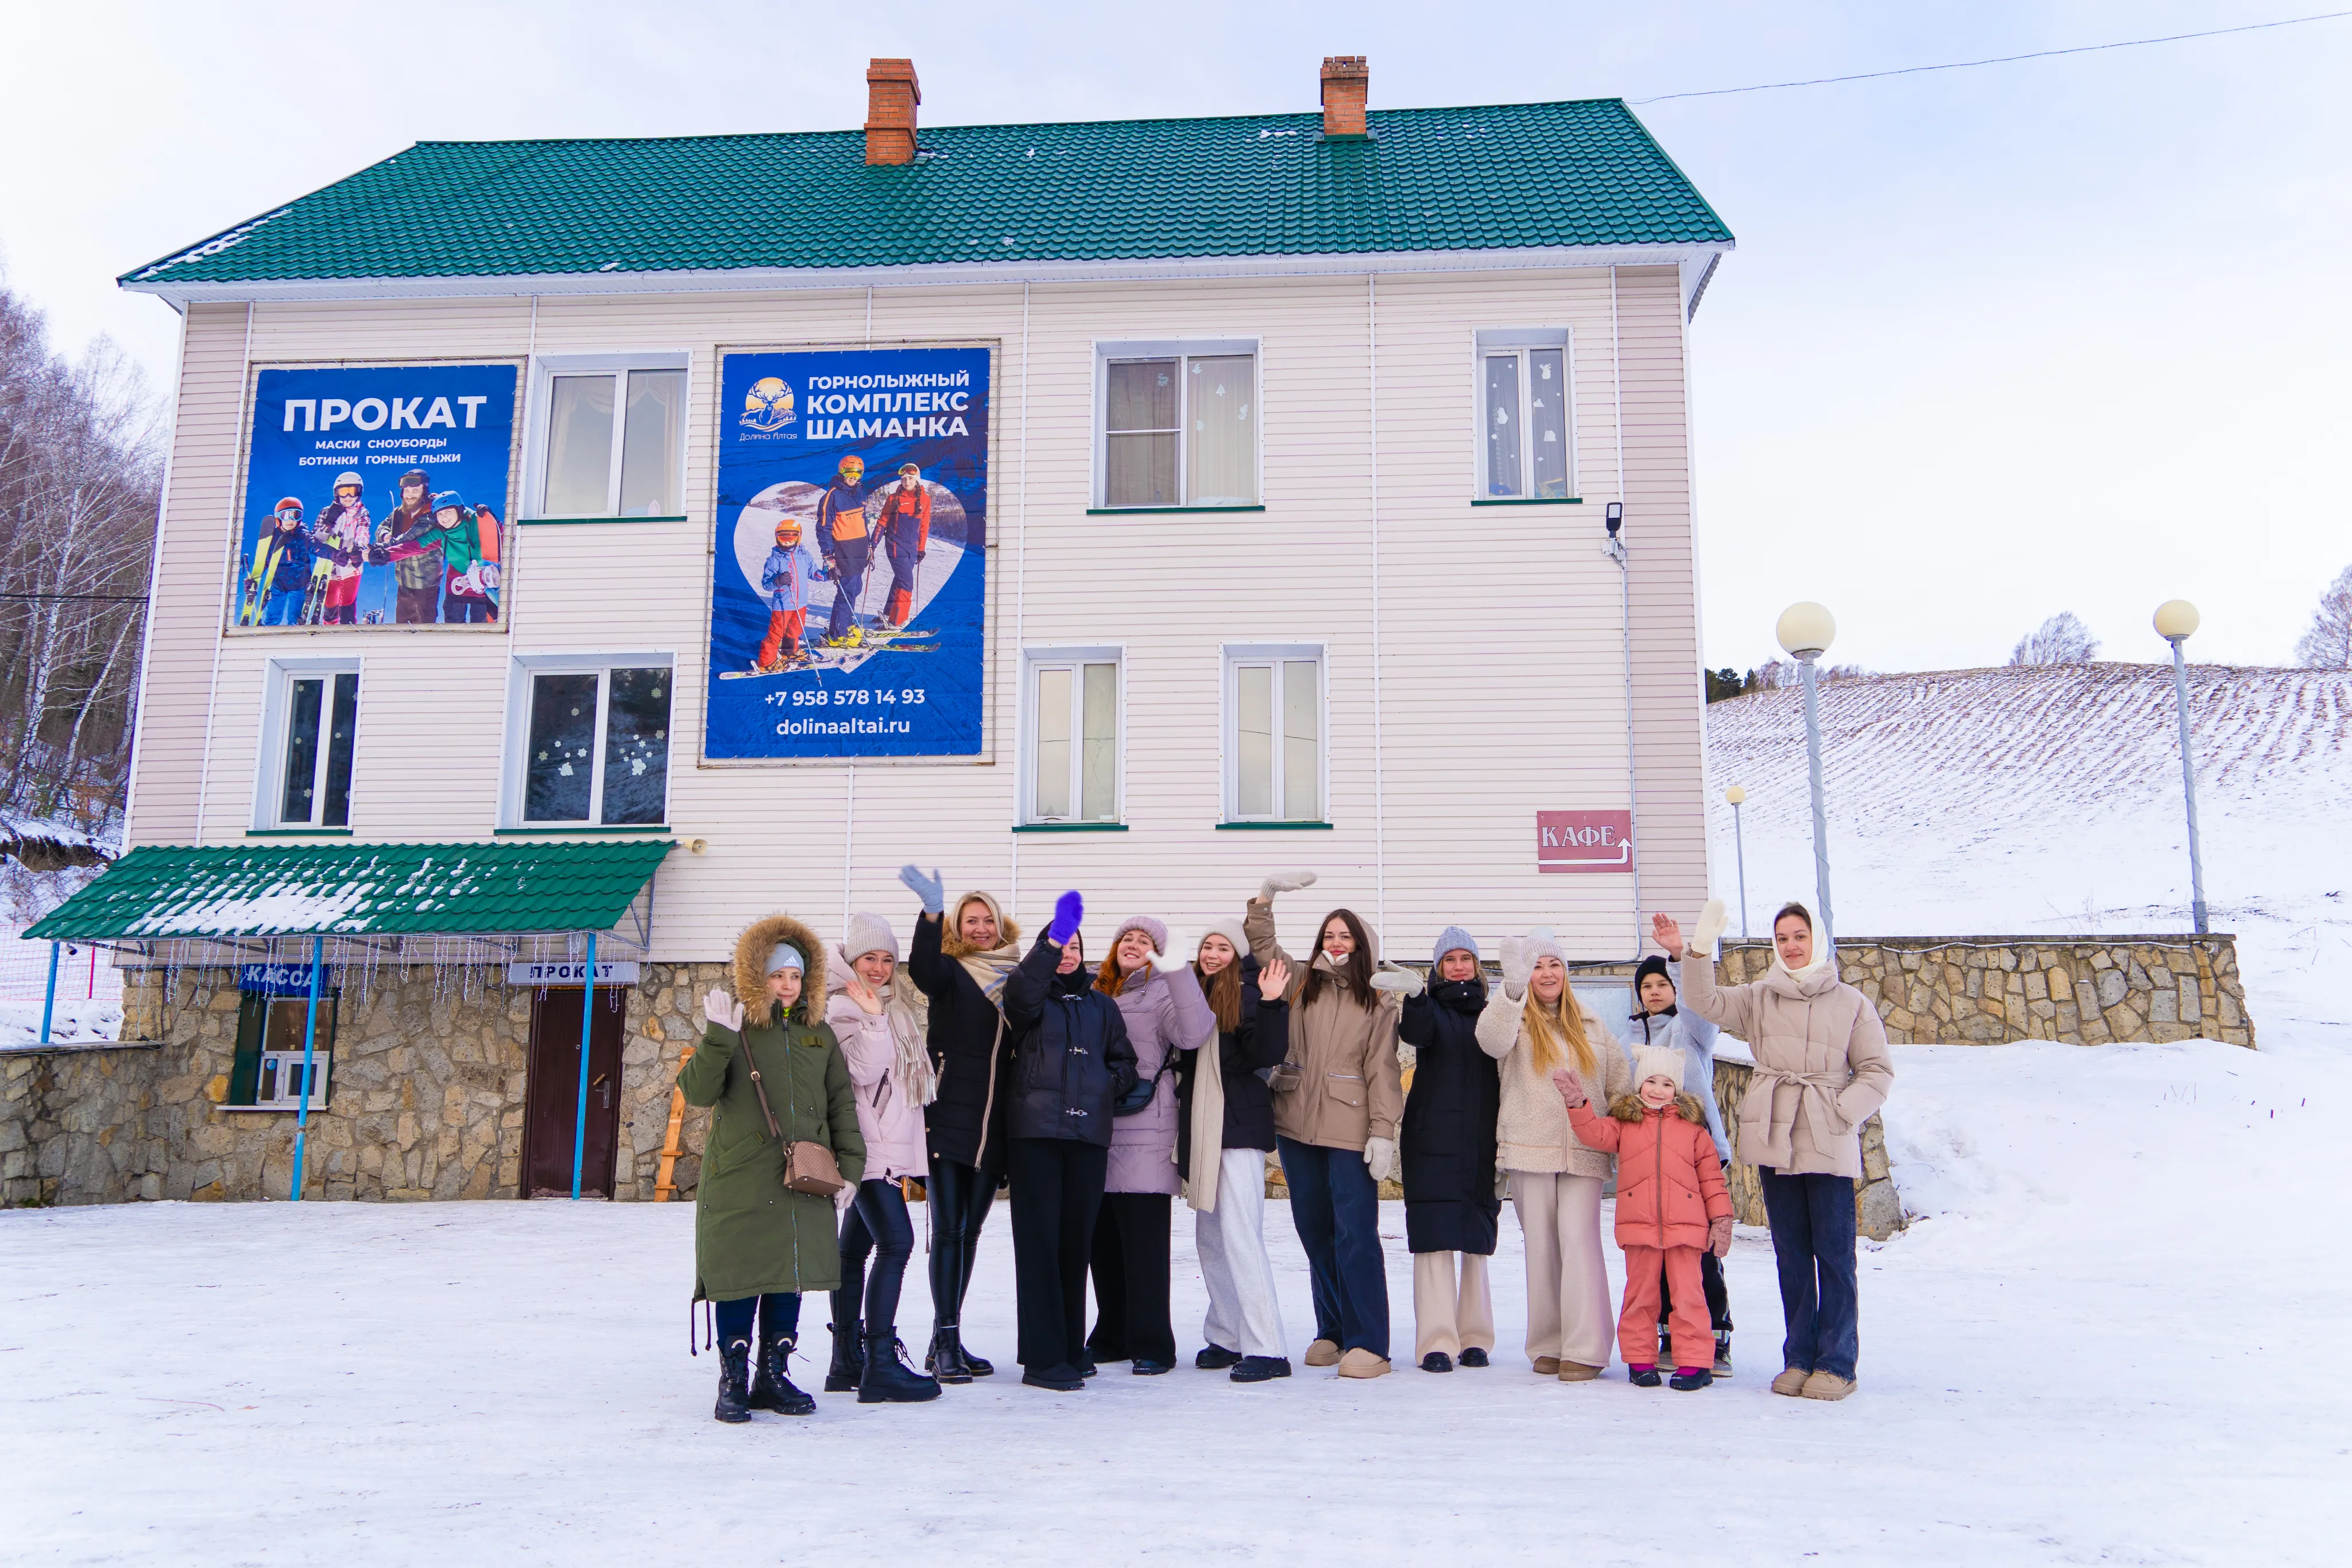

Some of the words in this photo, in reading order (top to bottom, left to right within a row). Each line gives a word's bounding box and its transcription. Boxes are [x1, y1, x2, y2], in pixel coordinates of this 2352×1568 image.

[808, 370, 970, 390] ГОРНОЛЫЖНЫЙ
[807, 392, 970, 415] КОМПЛЕКС
[283, 396, 487, 431] ПРОКАТ
[739, 433, 771, 442] Долина
[773, 432, 798, 440] Алтая
[806, 416, 969, 440] ШАМАНКА
[315, 440, 360, 450] МАСКИ
[368, 438, 447, 449] СНОУБОРДЫ
[299, 456, 358, 466] БОТИНКИ
[365, 455, 417, 464] ГОРНЫЕ
[420, 454, 461, 464] ЛЫЖИ
[765, 691, 787, 706] +7
[792, 690, 828, 706] 958
[834, 690, 869, 705] 578
[875, 690, 896, 704] 14
[902, 689, 925, 704] 93
[776, 717, 910, 735] dolinaaltai.ru
[1541, 825, 1616, 847] КАФЕ
